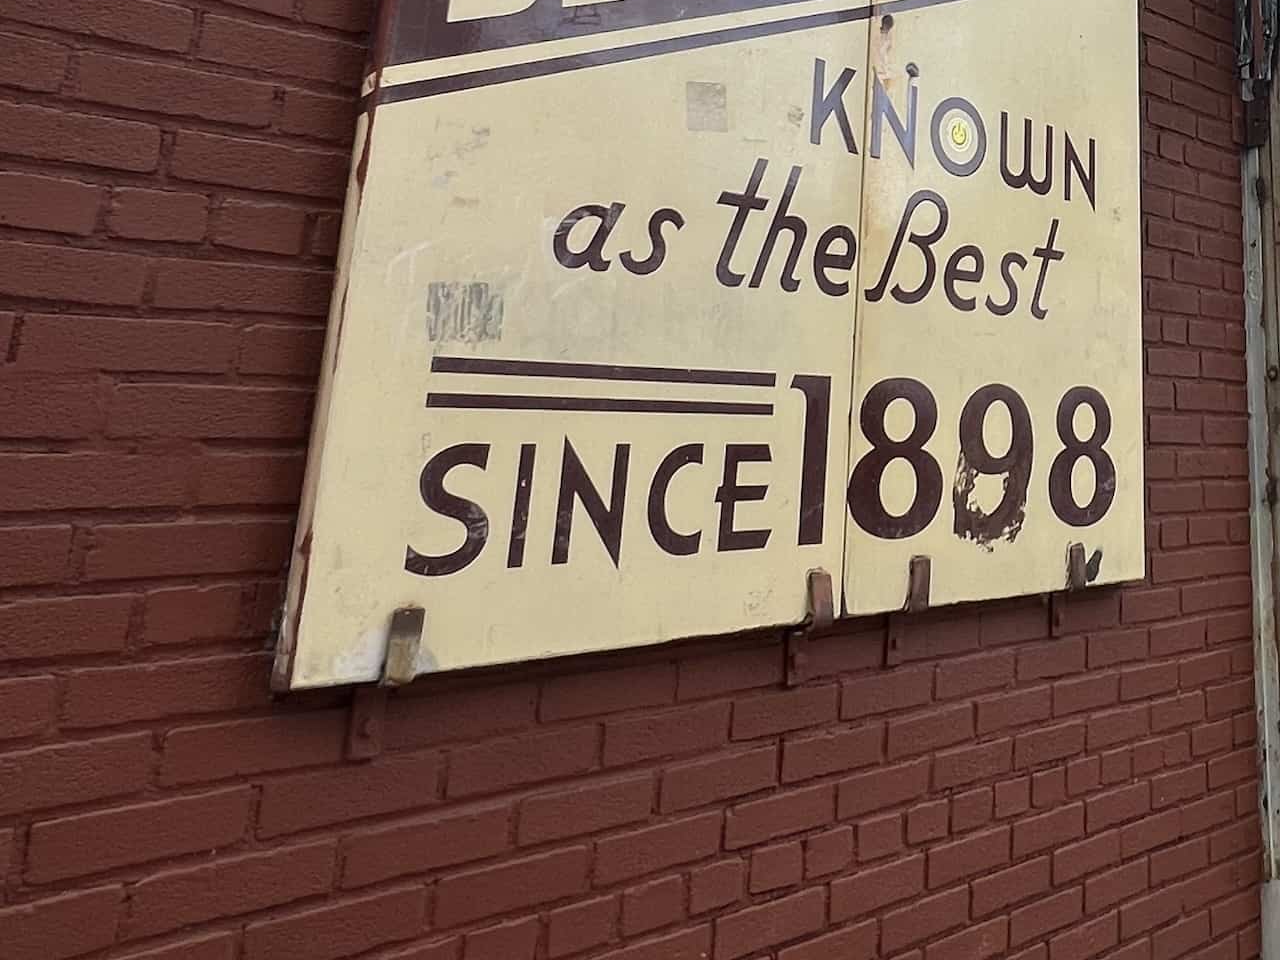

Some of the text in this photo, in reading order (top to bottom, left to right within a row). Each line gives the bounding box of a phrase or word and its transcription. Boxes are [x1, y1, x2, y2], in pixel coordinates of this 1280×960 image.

[810, 58, 1097, 212] KNOWN
[552, 157, 1064, 320] as the Best
[404, 374, 1117, 577] SINCE 1898
